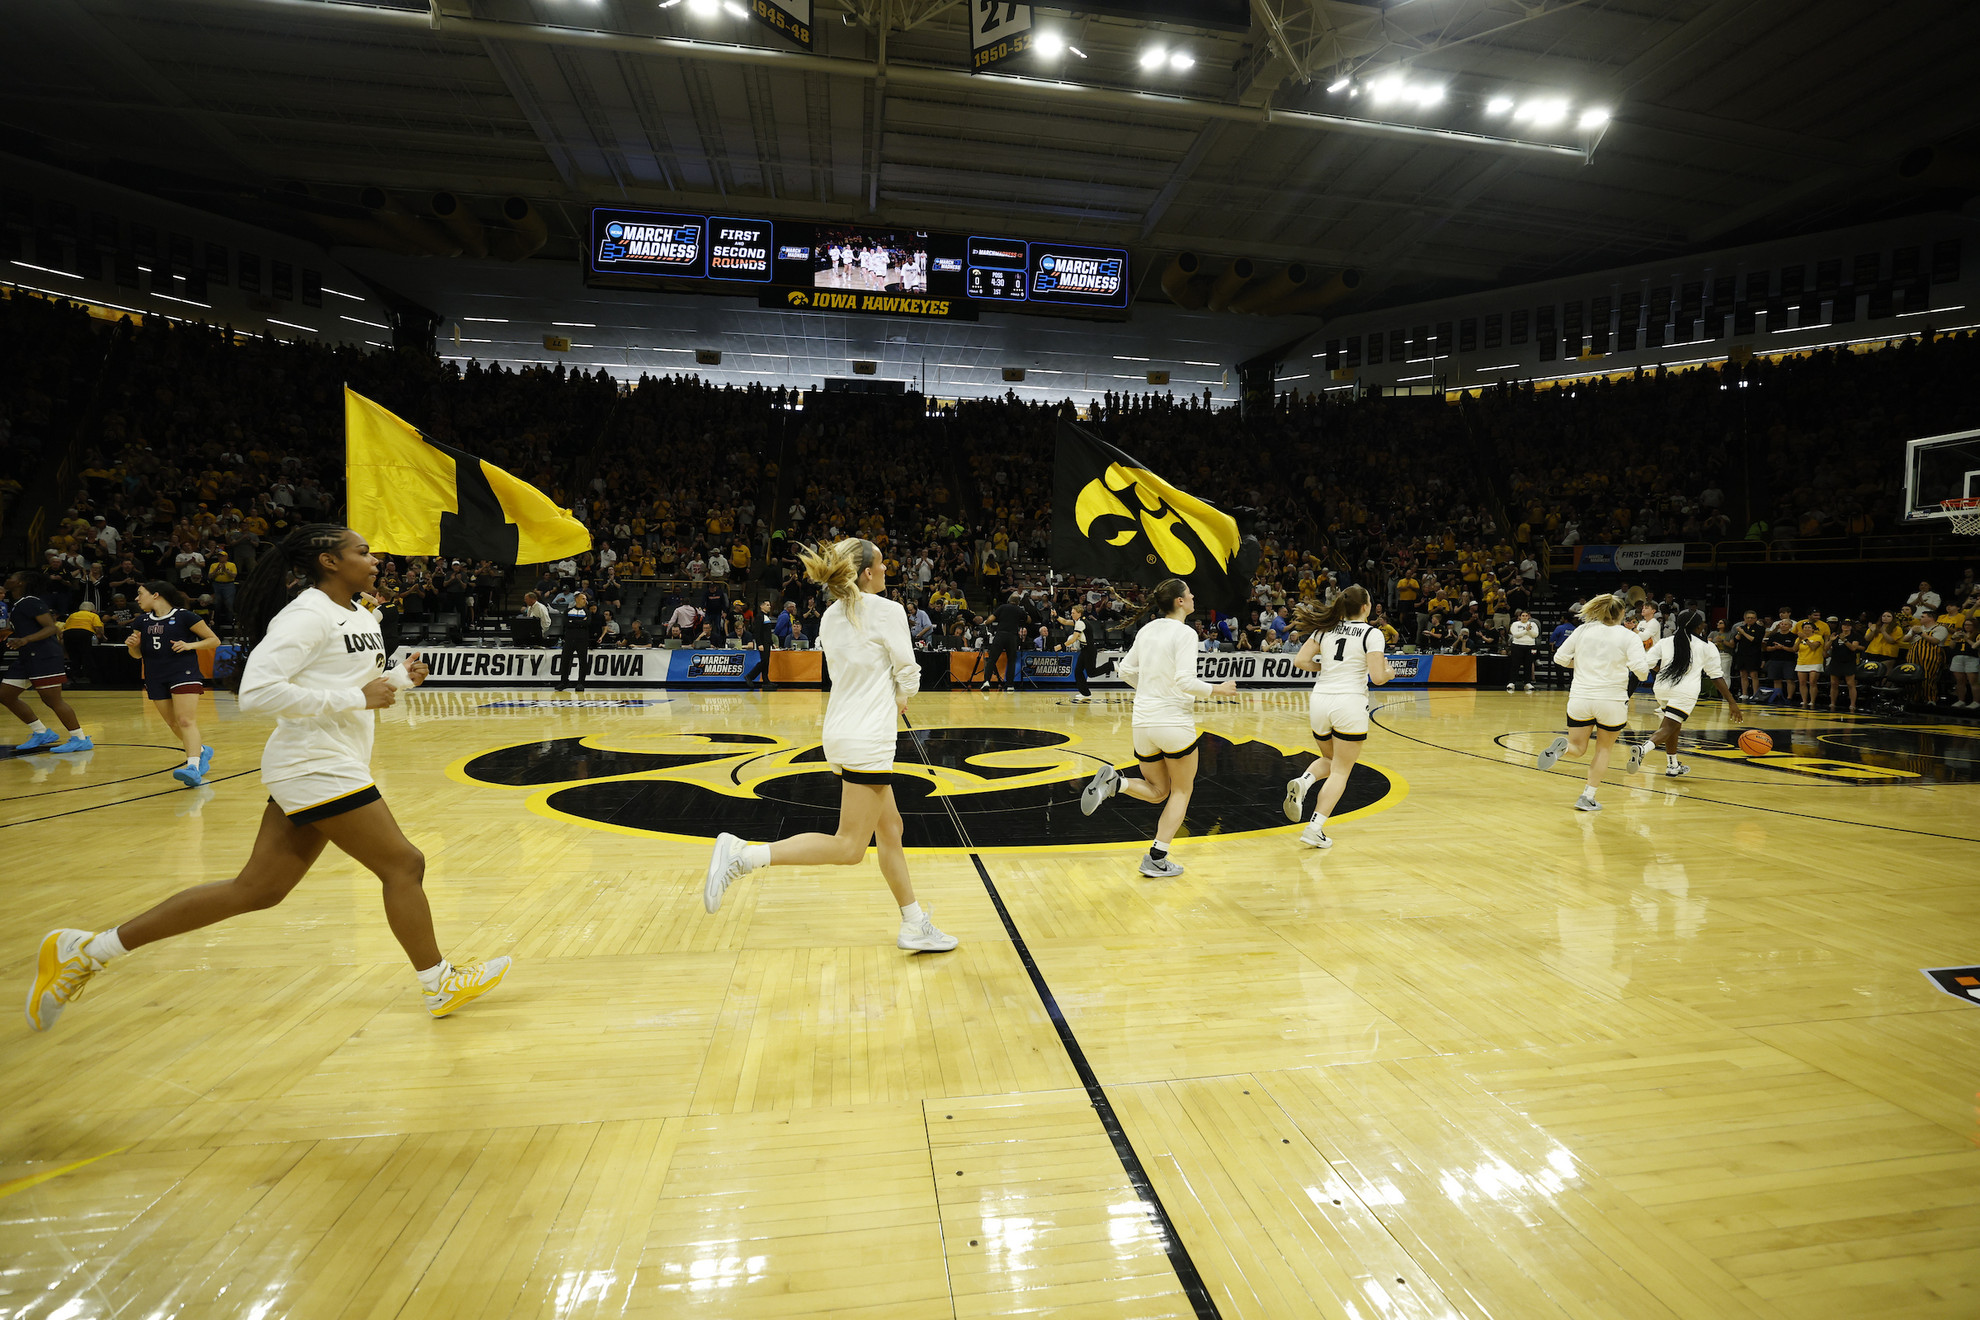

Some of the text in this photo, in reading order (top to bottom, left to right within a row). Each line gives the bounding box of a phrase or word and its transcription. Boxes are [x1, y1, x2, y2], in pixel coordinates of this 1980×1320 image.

[752, 0, 810, 43] 1945-48
[974, 34, 1033, 67] 1950-52
[623, 226, 673, 242] MARCH
[720, 229, 760, 241] FIRST
[629, 241, 696, 259] MADNESS
[713, 246, 765, 259] SECOND
[712, 257, 766, 271] ROUNDS
[1054, 259, 1098, 275] MARCH
[974, 276, 980, 285] 0
[1015, 279, 1021, 288] 0
[1060, 273, 1118, 290] MADNESS
[812, 292, 949, 315] IOWA HAWKEYES
[1650, 550, 1682, 558] SECOND
[1633, 558, 1669, 566] ROUNDS
[152, 636, 161, 650] 5
[1333, 637, 1347, 661] 1
[586, 654, 643, 676] IOWA
[700, 656, 730, 664] MARCH
[1196, 656, 1256, 678] ECOND
[704, 664, 743, 673] MADNESS
